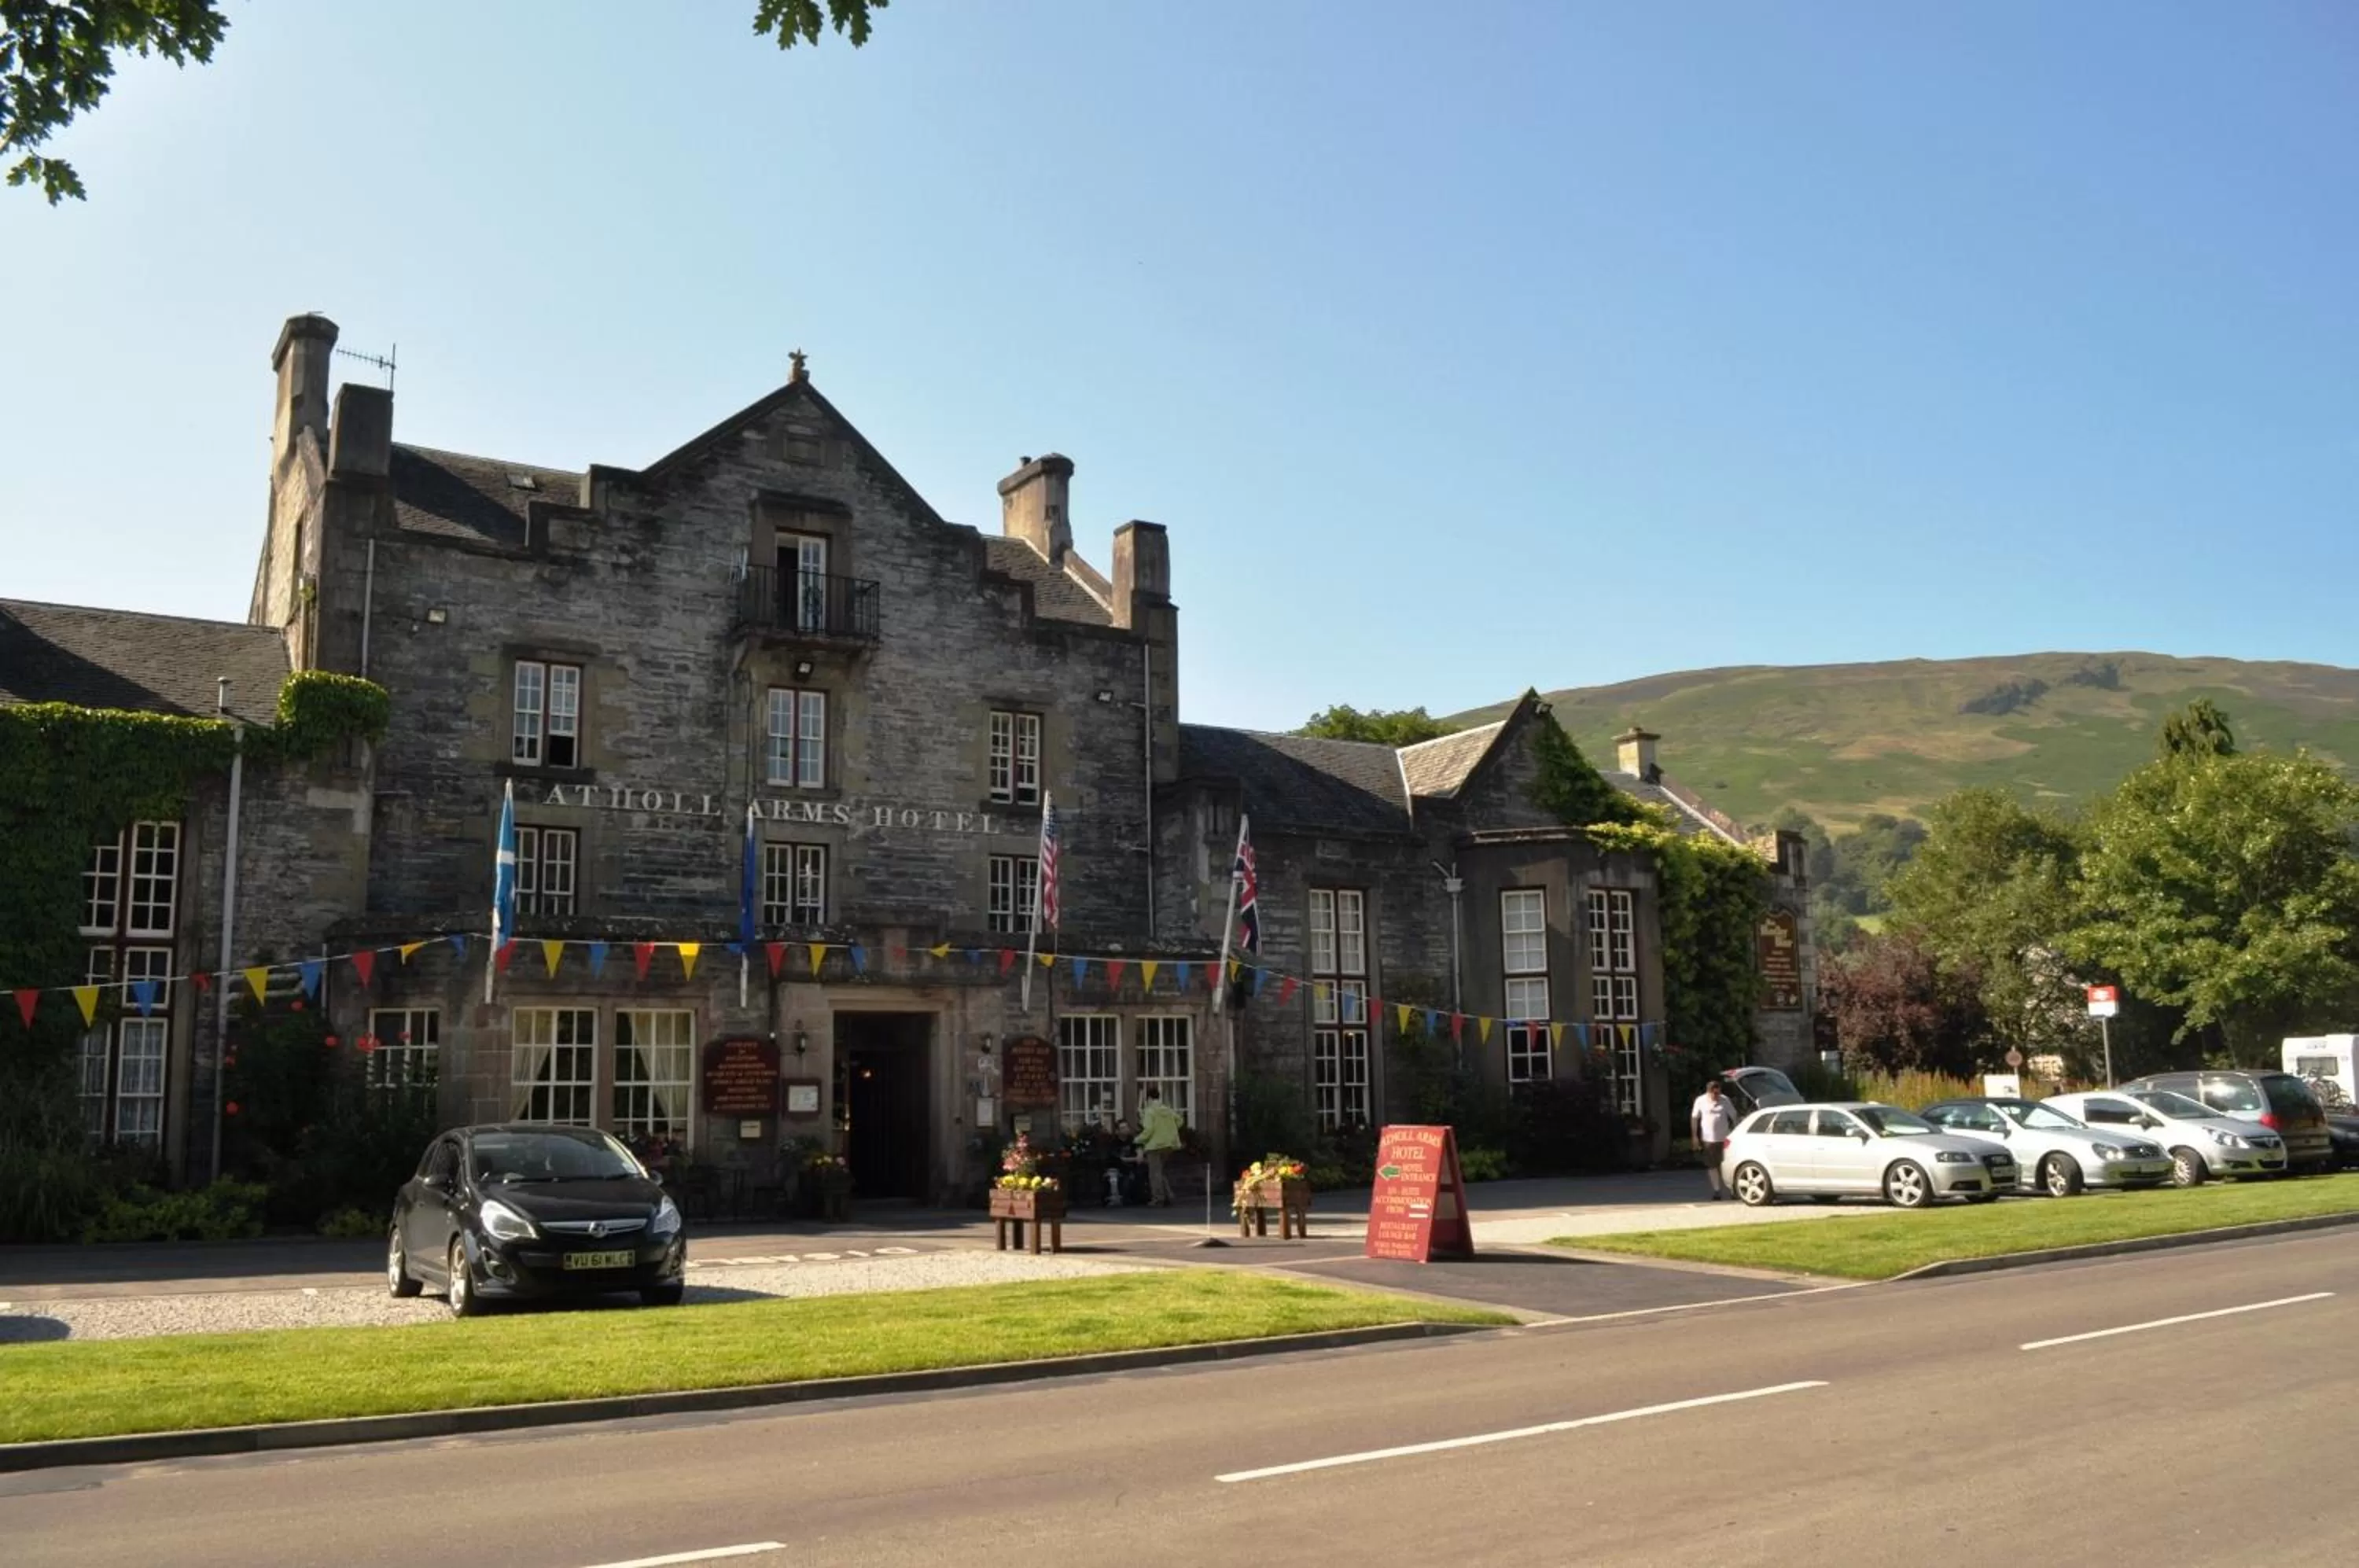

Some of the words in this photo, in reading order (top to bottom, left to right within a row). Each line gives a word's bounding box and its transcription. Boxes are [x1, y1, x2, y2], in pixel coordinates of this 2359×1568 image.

[543, 783, 721, 815] ATHOLL
[748, 798, 850, 824] ARMS
[874, 805, 1001, 834] HOTEL
[1391, 1147, 1426, 1160] HOTEL
